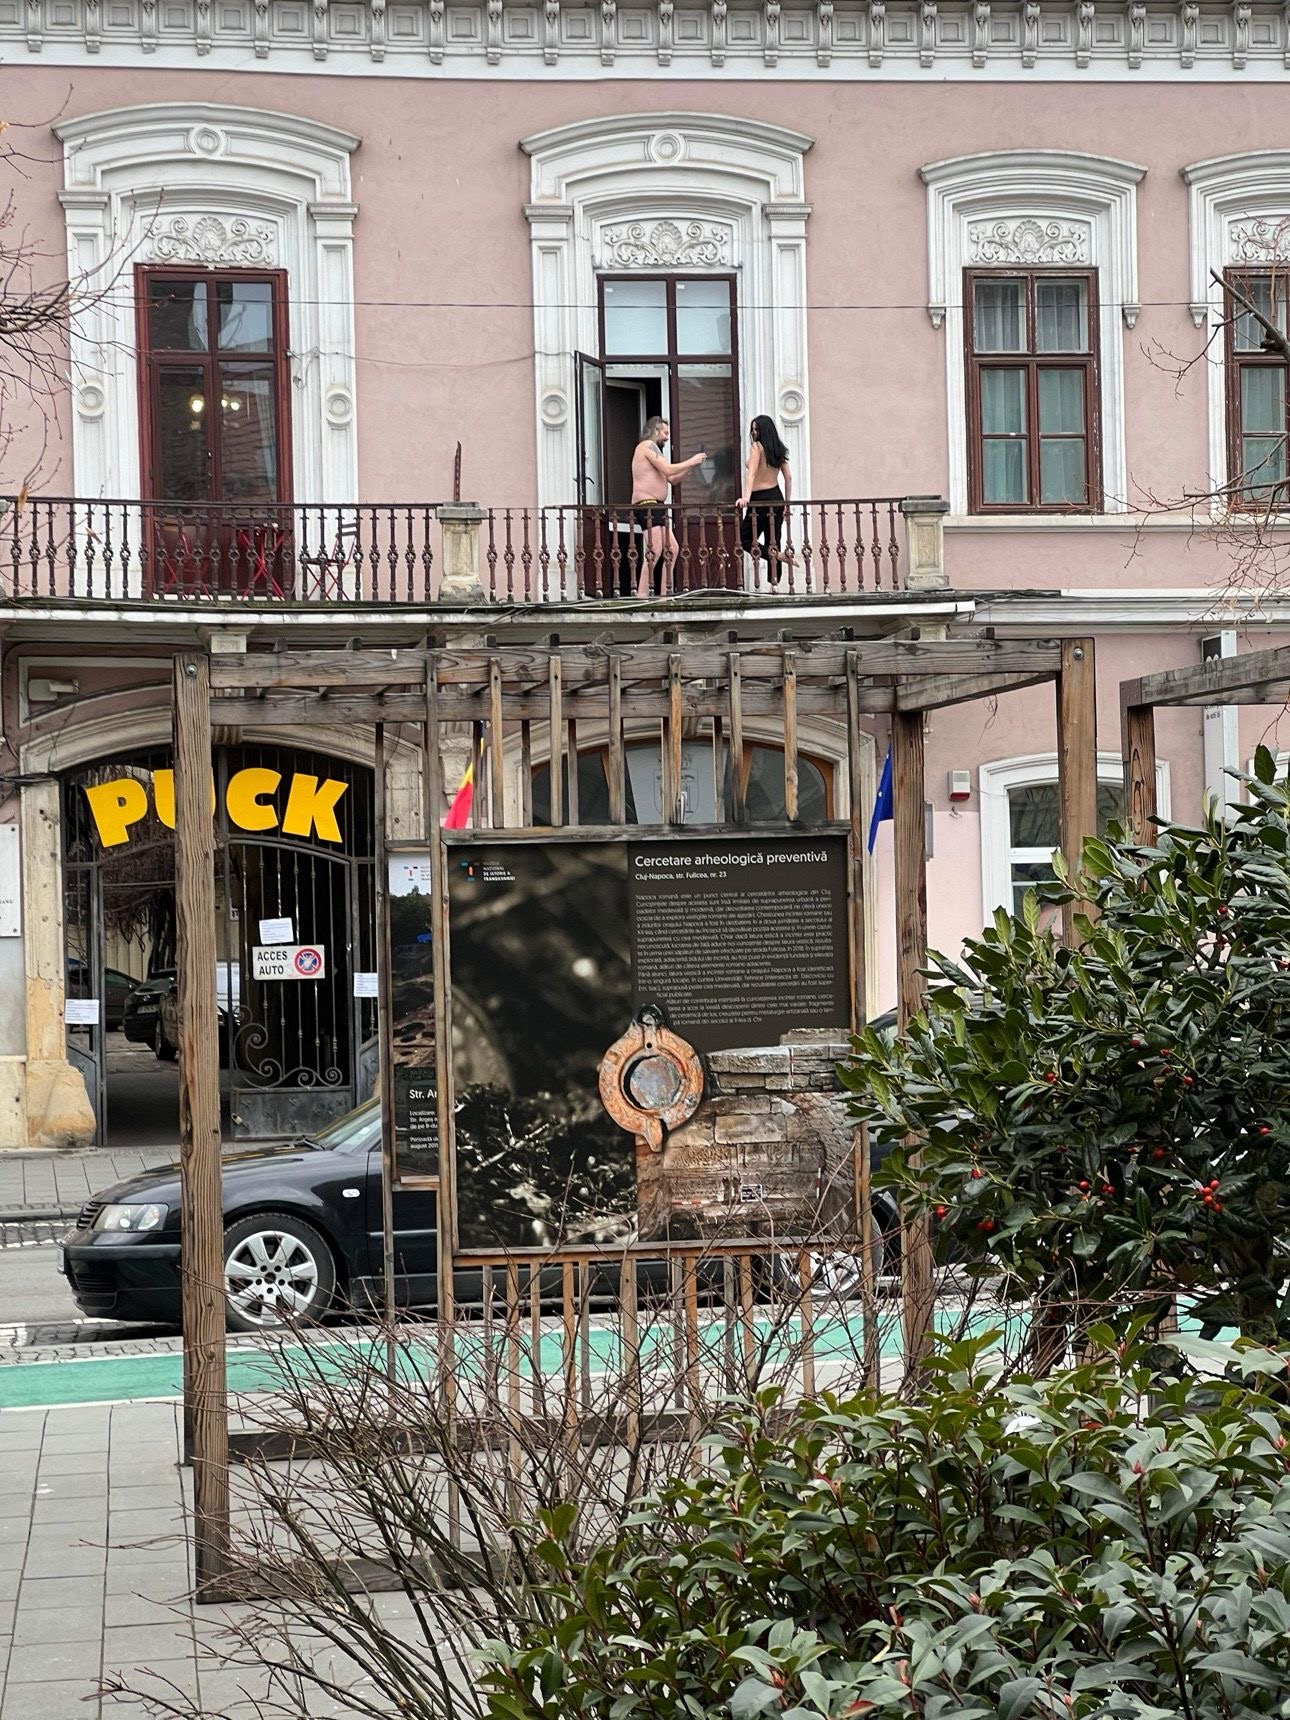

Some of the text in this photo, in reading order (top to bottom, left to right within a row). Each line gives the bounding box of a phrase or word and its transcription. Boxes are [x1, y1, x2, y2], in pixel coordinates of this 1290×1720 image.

[635, 851, 828, 867] Cercetare arheologică preventivă
[635, 873, 675, 881] Cluj-Napoca,
[719, 870, 727, 878] 23
[257, 950, 288, 961] ACCES
[259, 966, 284, 976] AUTO
[409, 1089, 425, 1099] Str.
